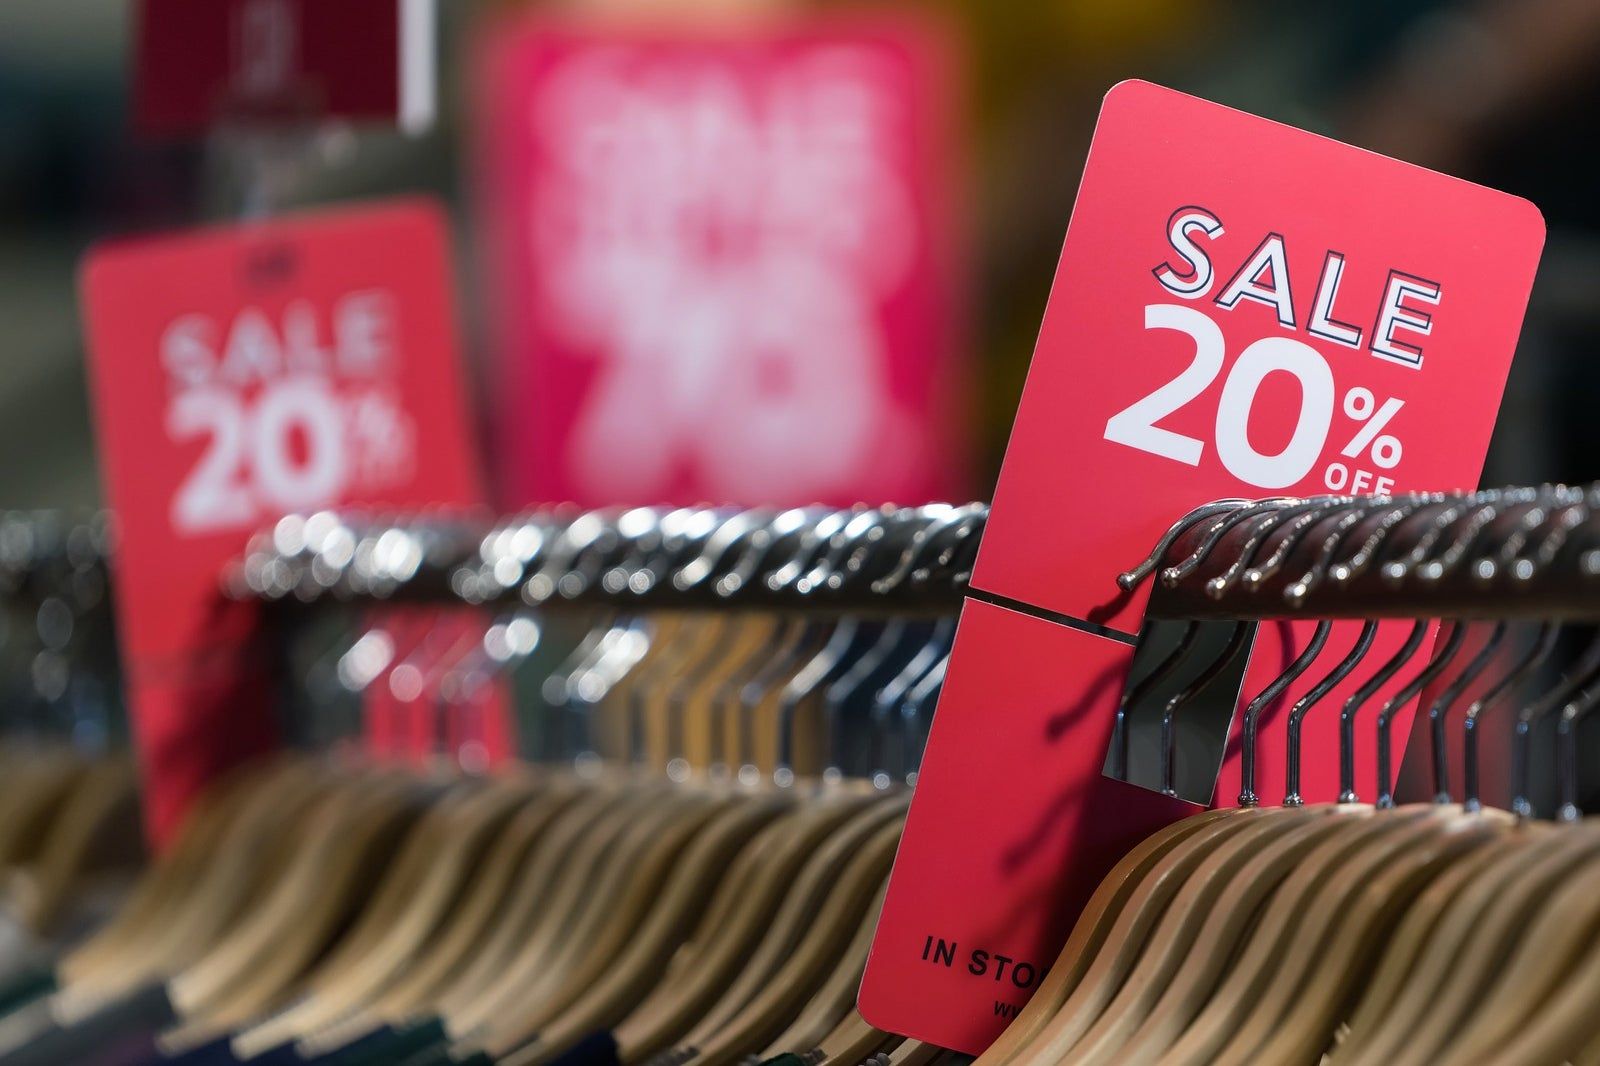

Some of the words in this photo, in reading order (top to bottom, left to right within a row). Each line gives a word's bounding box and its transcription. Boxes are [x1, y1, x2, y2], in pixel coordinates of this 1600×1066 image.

[1152, 205, 1442, 370] SALE
[159, 291, 397, 384] SALE
[1324, 462, 1395, 498] OFF
[922, 935, 957, 967] IN
